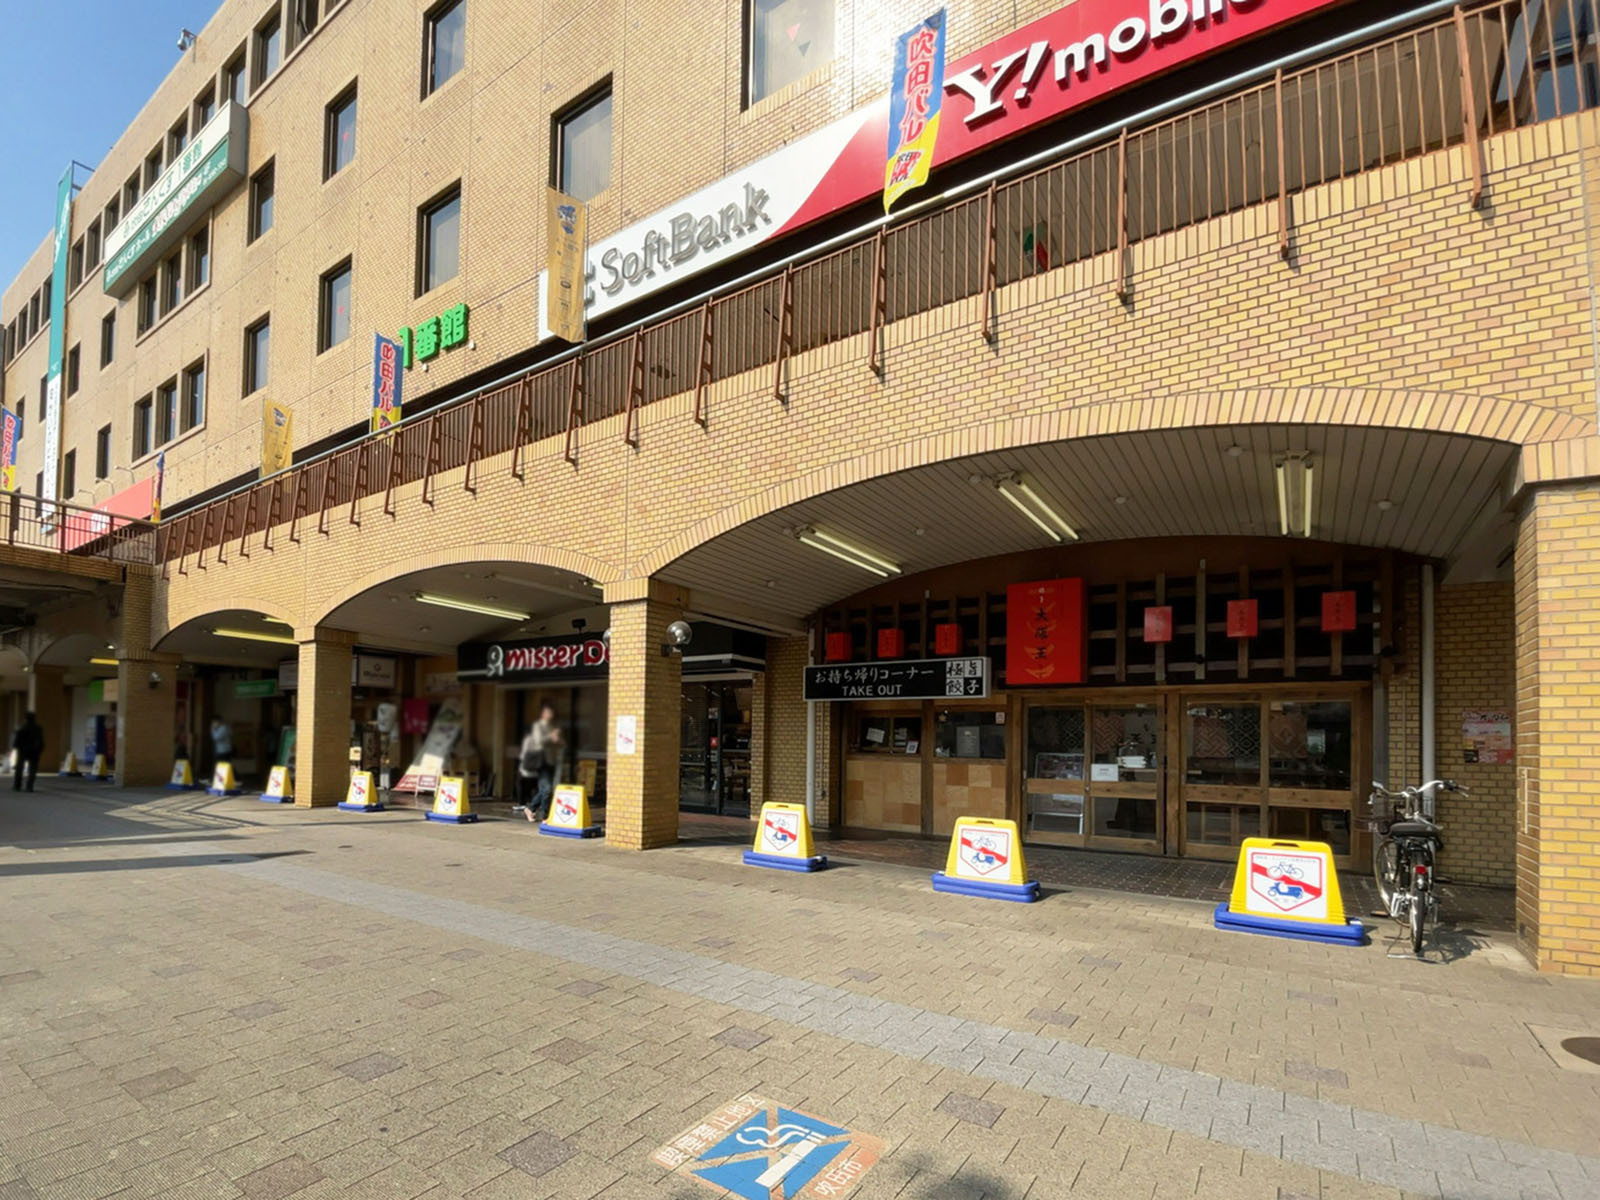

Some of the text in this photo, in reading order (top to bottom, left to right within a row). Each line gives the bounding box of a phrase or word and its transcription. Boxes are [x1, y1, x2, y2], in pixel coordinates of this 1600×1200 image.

[900, 29, 936, 148] 吹田バル
[943, 0, 1261, 125] Y!mobi
[600, 182, 772, 294] SoftBank
[506, 643, 583, 670] mister
[815, 665, 935, 684] お持ち帰りコーナー
[842, 684, 903, 697] TAKE OUT
[655, 1094, 766, 1166] 喫煙禁止地区
[814, 1158, 863, 1196] 吹田市
